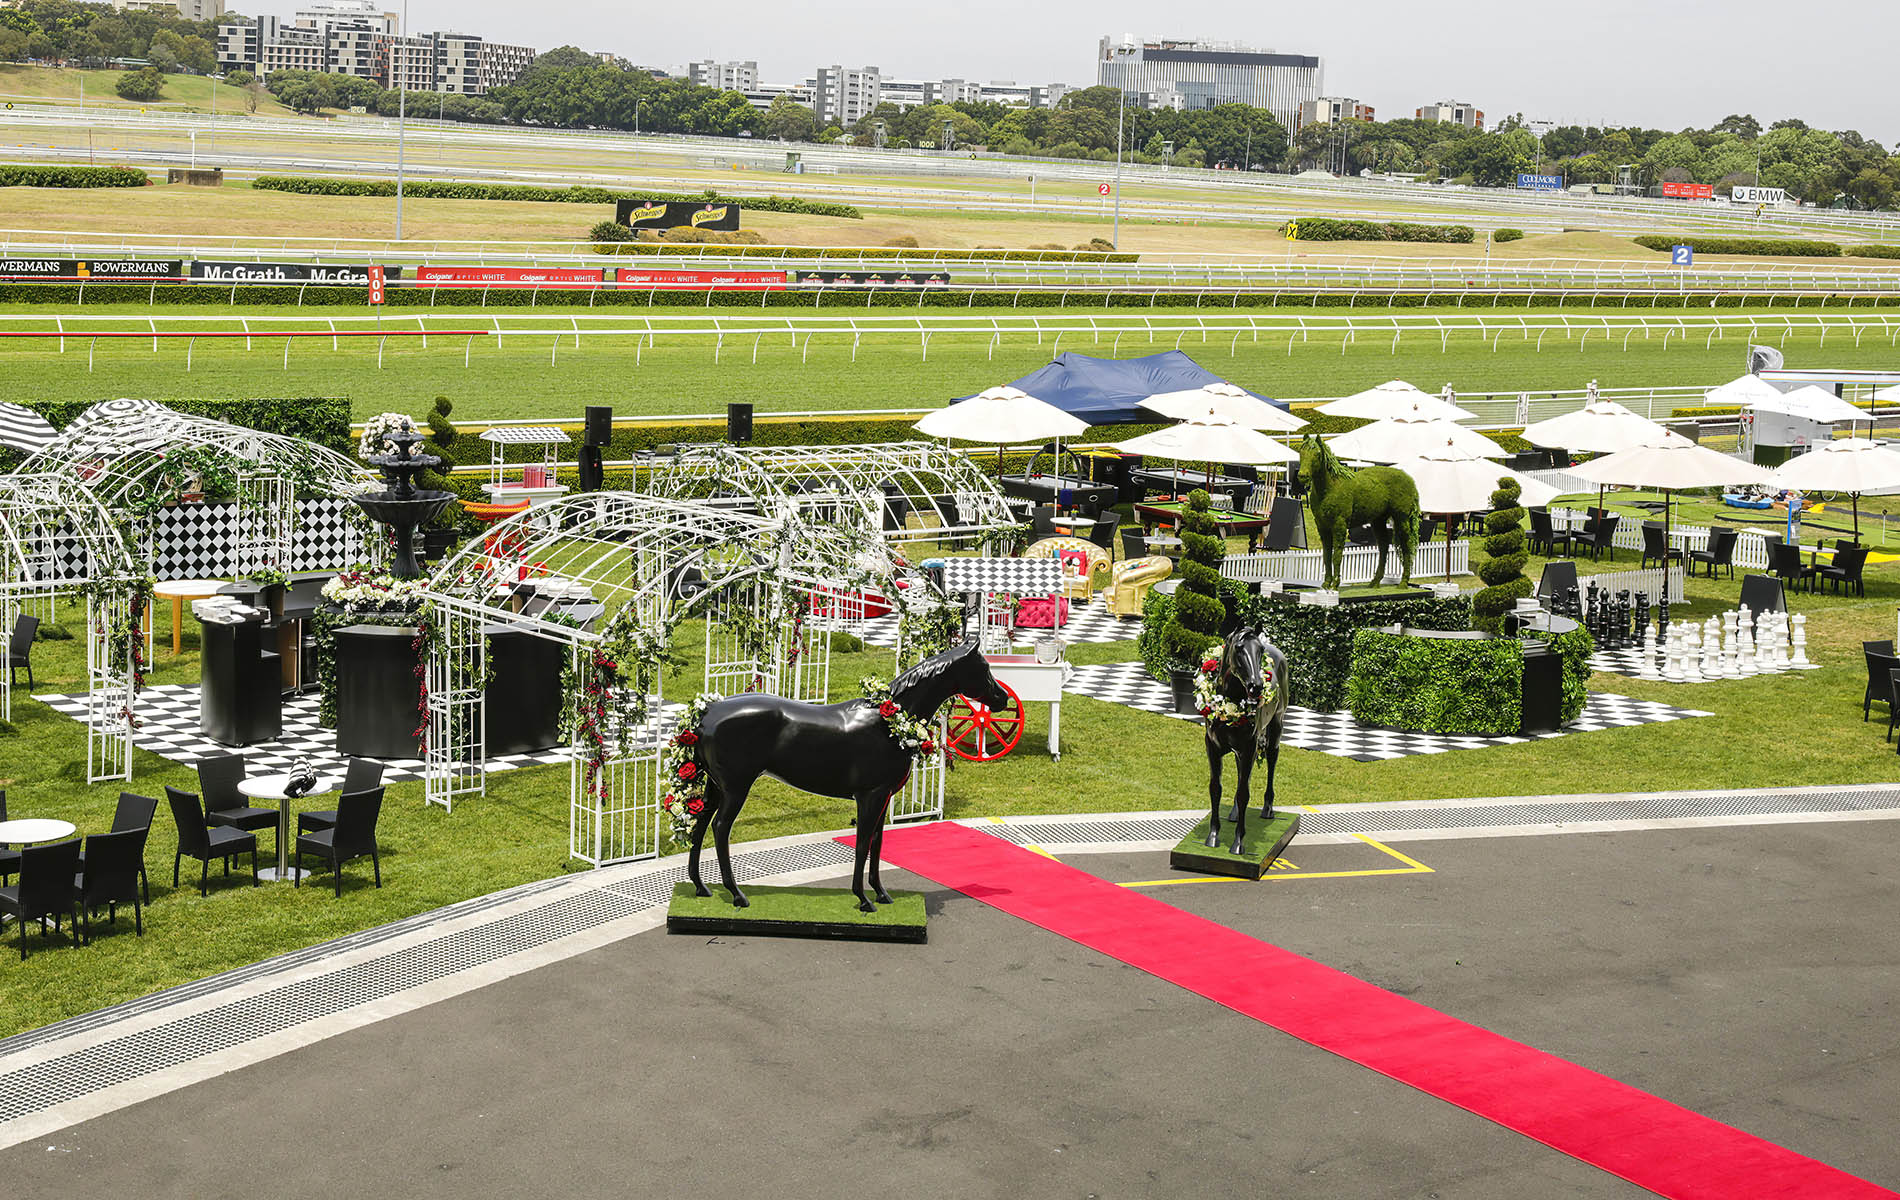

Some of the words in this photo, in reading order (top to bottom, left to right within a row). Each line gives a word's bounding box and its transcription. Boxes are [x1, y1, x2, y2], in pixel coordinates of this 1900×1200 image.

[919, 140, 935, 148] 1000
[1100, 184, 1109, 194] 2
[1749, 189, 1783, 201] BMW
[1287, 226, 1297, 239] X
[1676, 247, 1689, 263] 2
[93, 262, 169, 273] BOWERMANS
[203, 265, 286, 280] McGrath
[482, 273, 505, 281] WHITE
